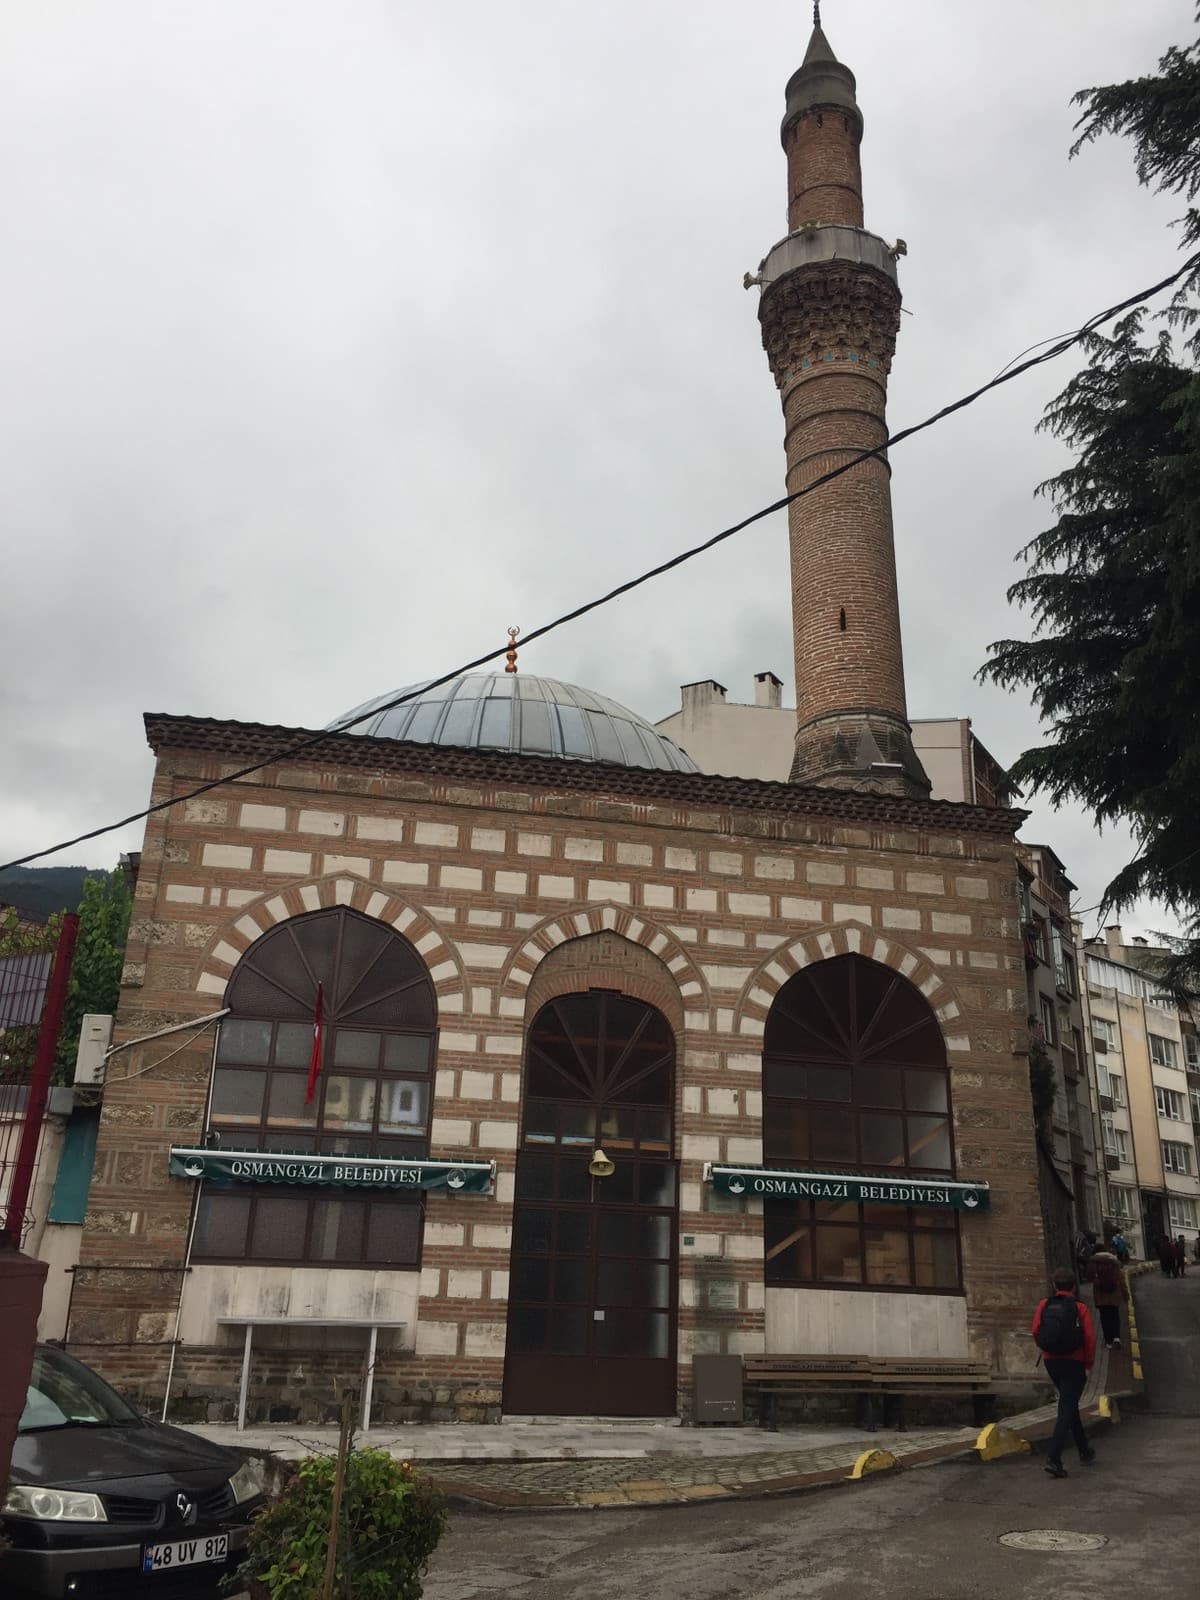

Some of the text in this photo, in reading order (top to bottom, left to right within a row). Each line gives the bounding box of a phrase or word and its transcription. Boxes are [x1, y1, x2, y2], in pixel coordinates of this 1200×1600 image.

[231, 1160, 423, 1184] OSMANGAZİ BELEDİYESİ
[753, 1178, 951, 1203] OSMANGAZİ BELEDİYESİ
[153, 1536, 226, 1567] 48 UV 812
